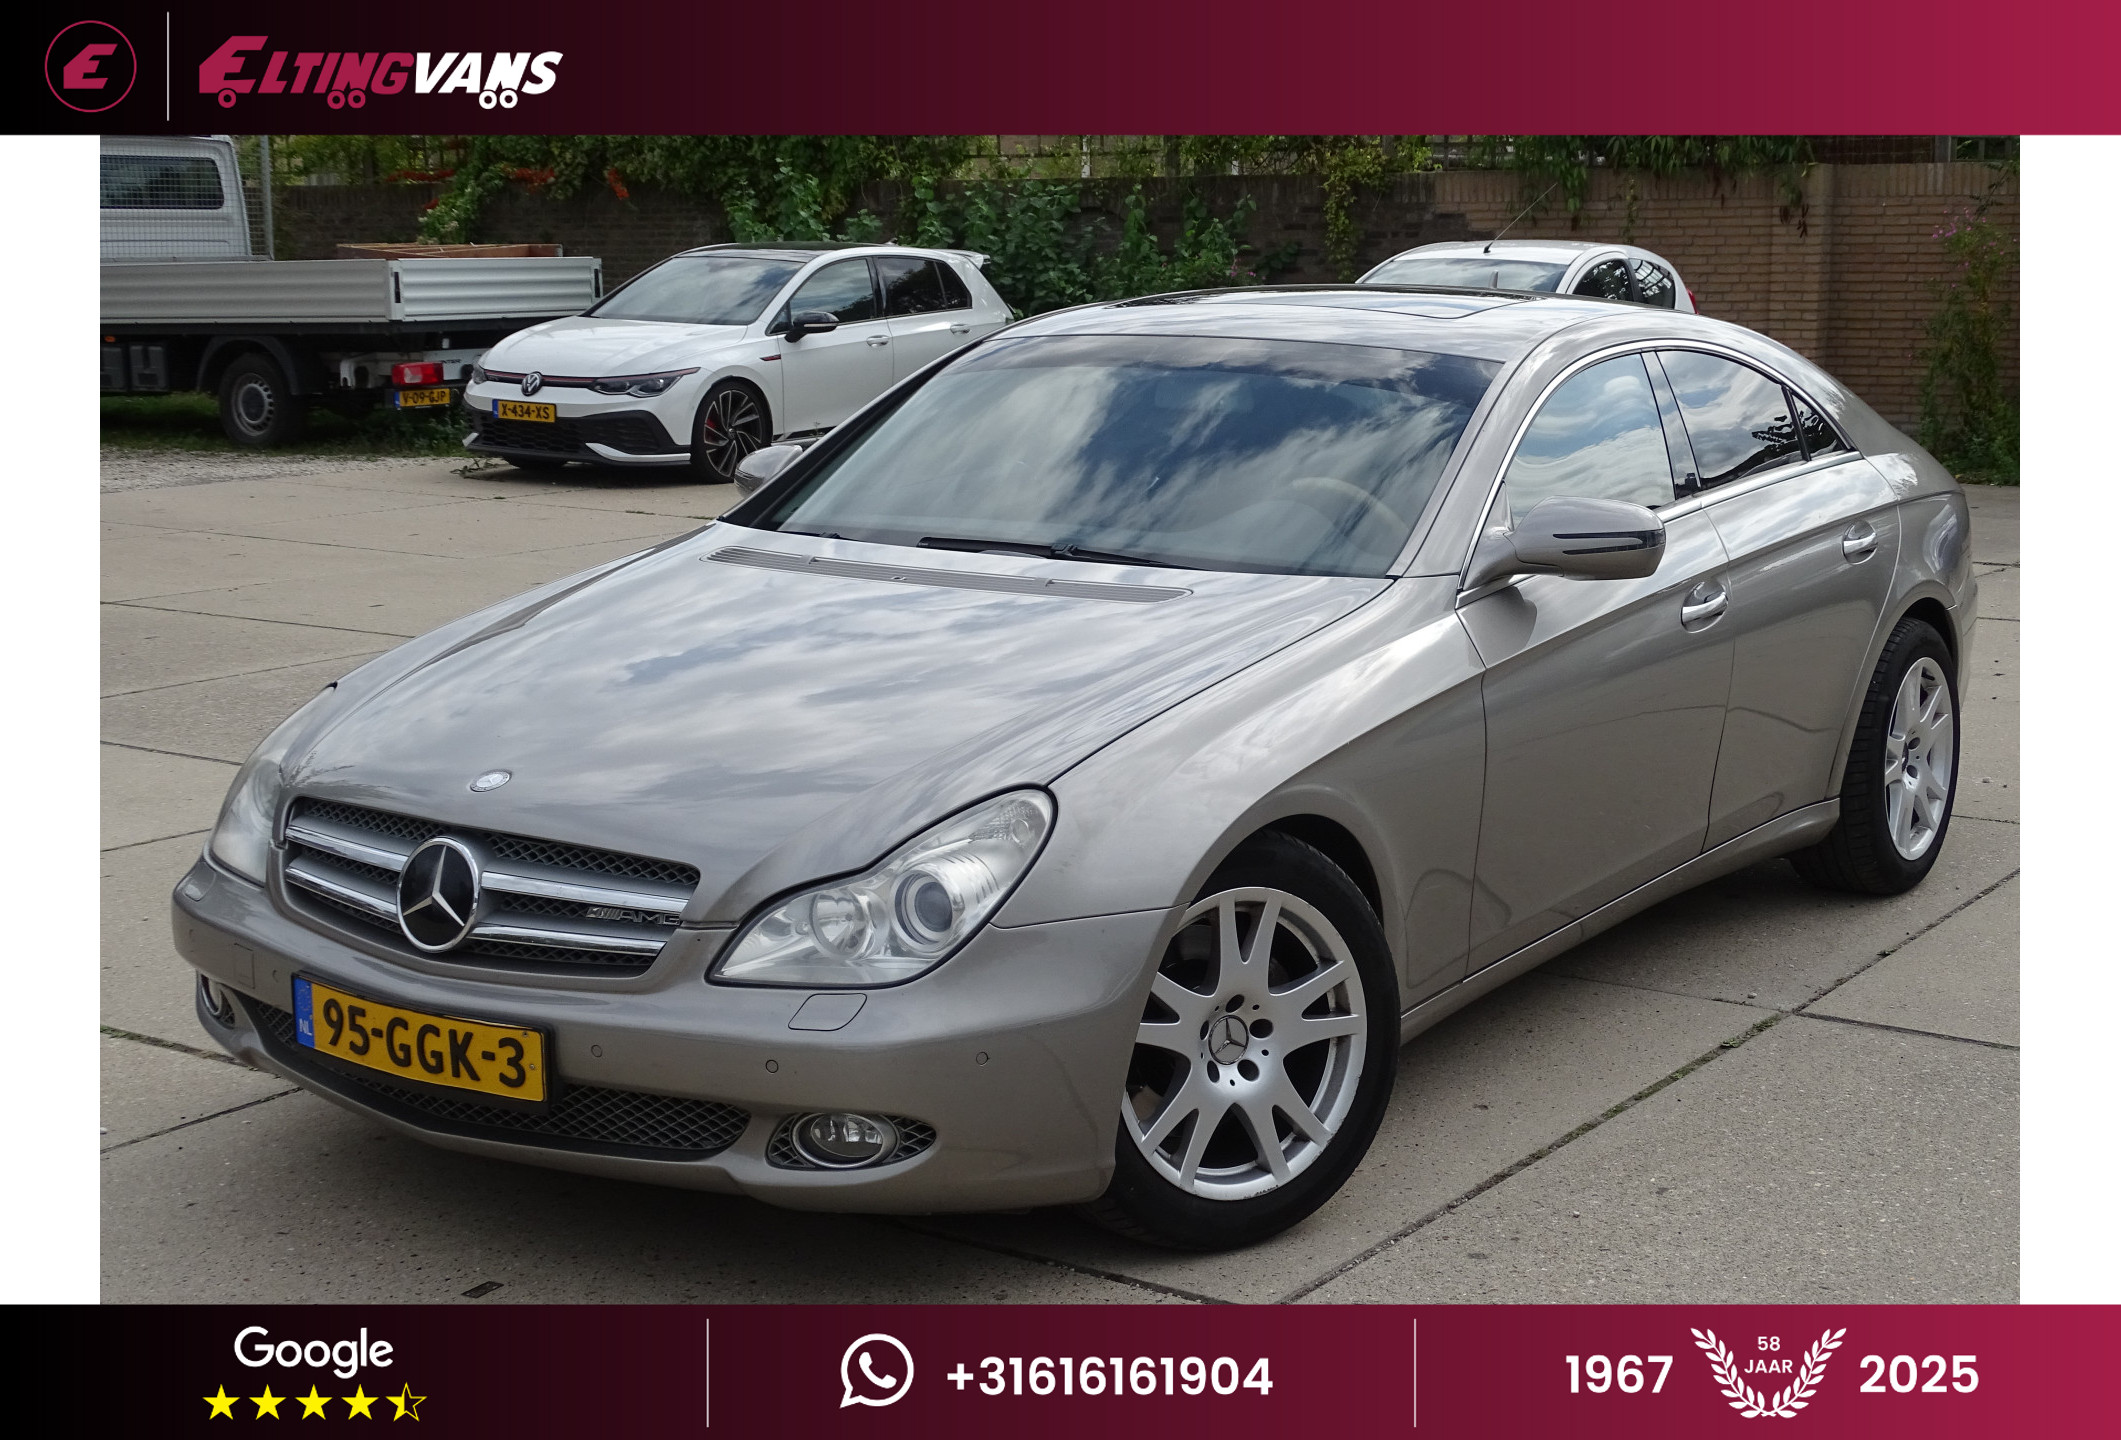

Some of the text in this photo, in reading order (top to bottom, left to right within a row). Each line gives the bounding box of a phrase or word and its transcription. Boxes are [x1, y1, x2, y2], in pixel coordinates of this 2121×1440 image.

[402, 391, 446, 404] V-09-GJP
[501, 403, 550, 419] X-434-XS
[620, 909, 680, 926] AMG
[299, 1018, 313, 1036] NL
[323, 998, 526, 1088] 95-GGK-3
